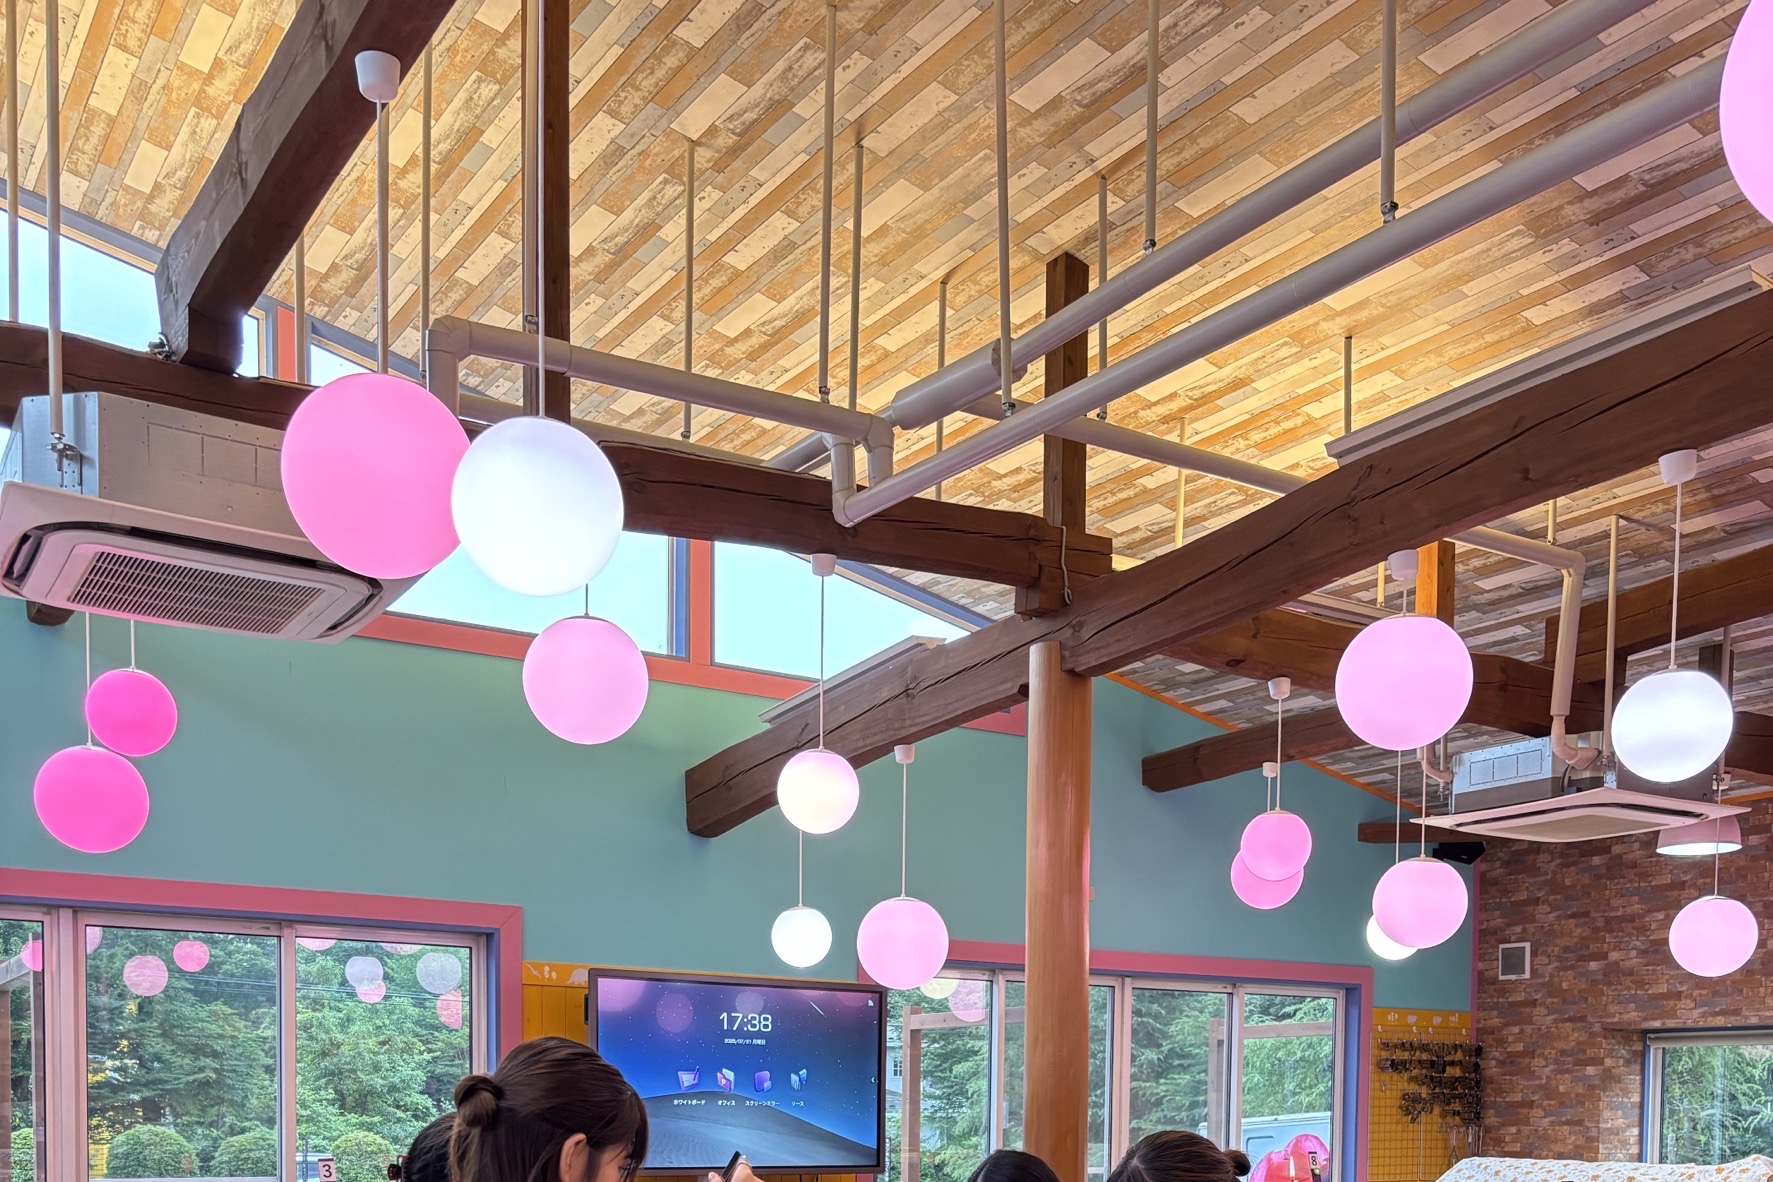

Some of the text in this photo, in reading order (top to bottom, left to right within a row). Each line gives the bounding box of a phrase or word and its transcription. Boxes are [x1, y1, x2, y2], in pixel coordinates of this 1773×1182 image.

[719, 1011, 772, 1032] 17:38
[1310, 1155, 1318, 1167] 8
[322, 1163, 333, 1178] 3
